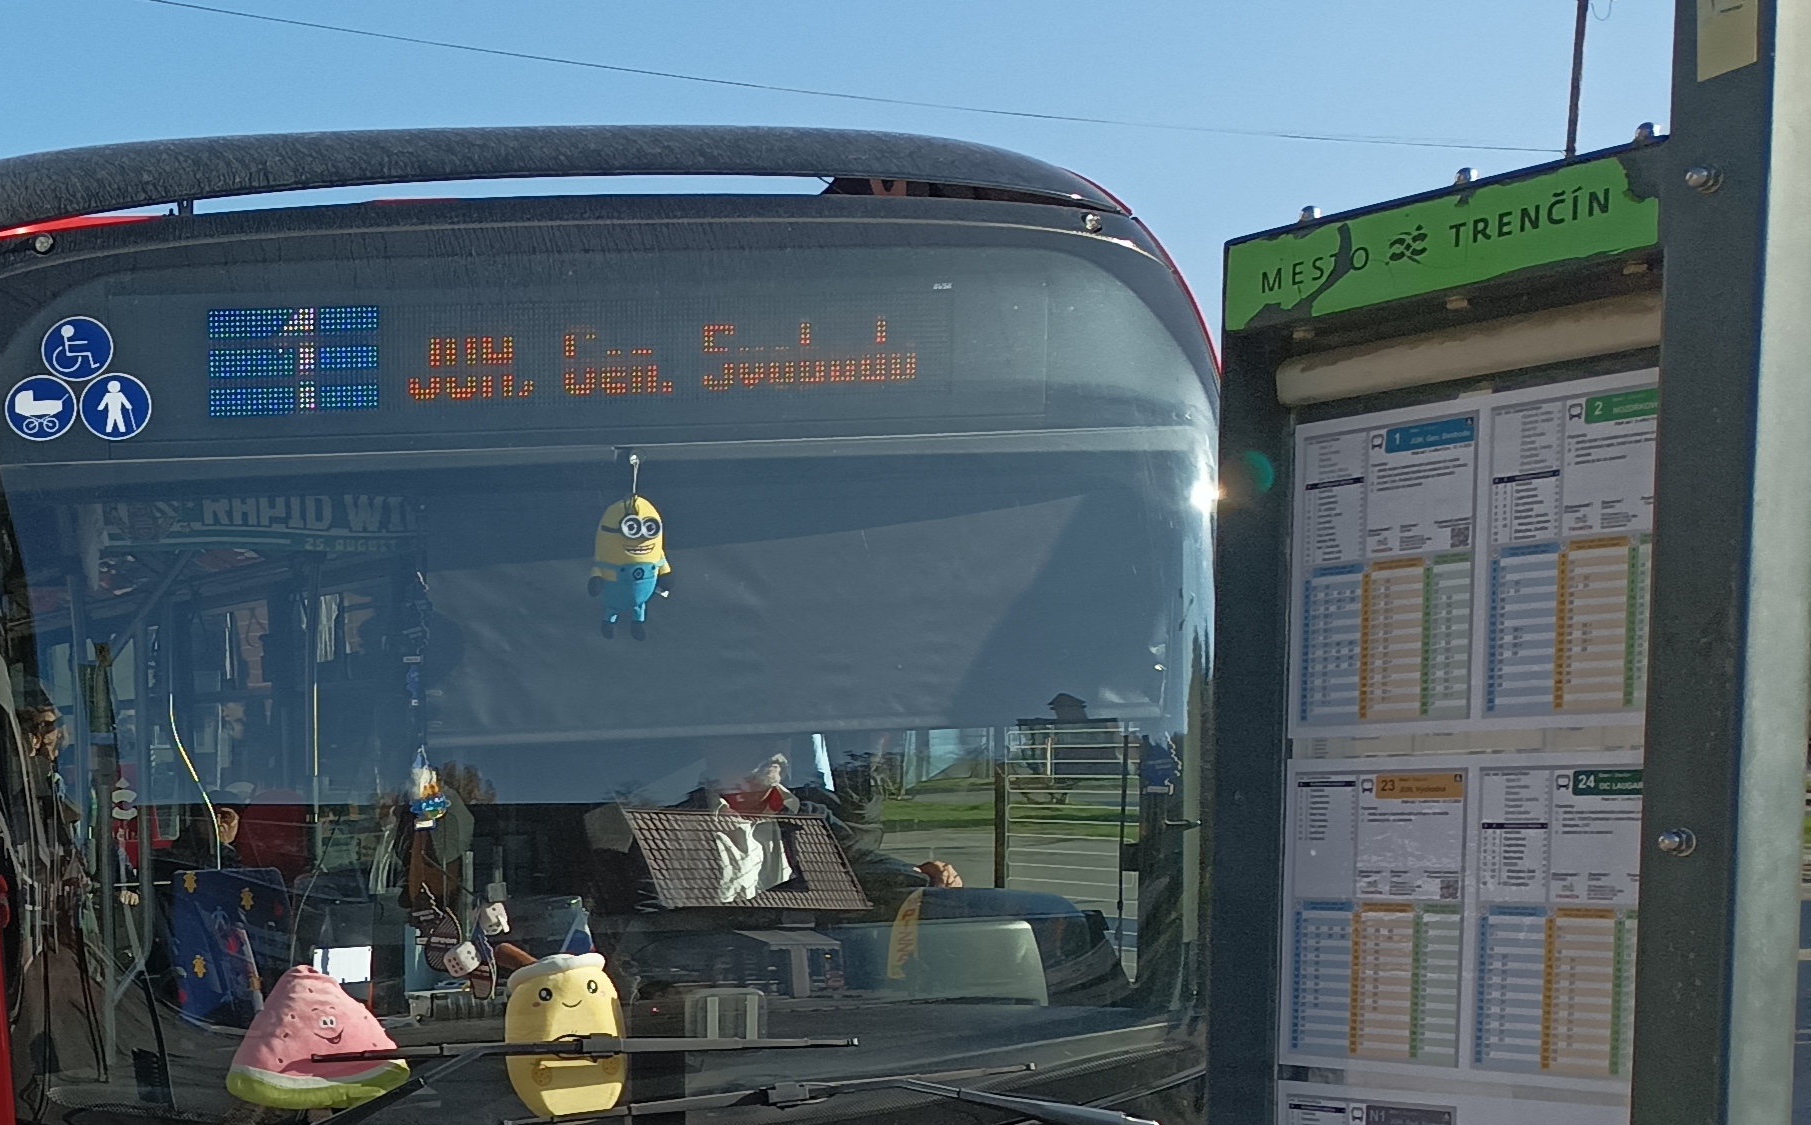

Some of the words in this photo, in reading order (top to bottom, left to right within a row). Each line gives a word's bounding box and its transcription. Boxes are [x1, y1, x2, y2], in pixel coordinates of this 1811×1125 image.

[1448, 185, 1611, 248] TRENČÍN
[1594, 401, 1603, 415] 2
[1393, 432, 1401, 445] 1
[202, 495, 332, 531] RAPID
[335, 538, 398, 553] AUGUST
[1381, 779, 1395, 791] 23
[1578, 774, 1595, 788] 24
[1370, 1109, 1385, 1122] N1
